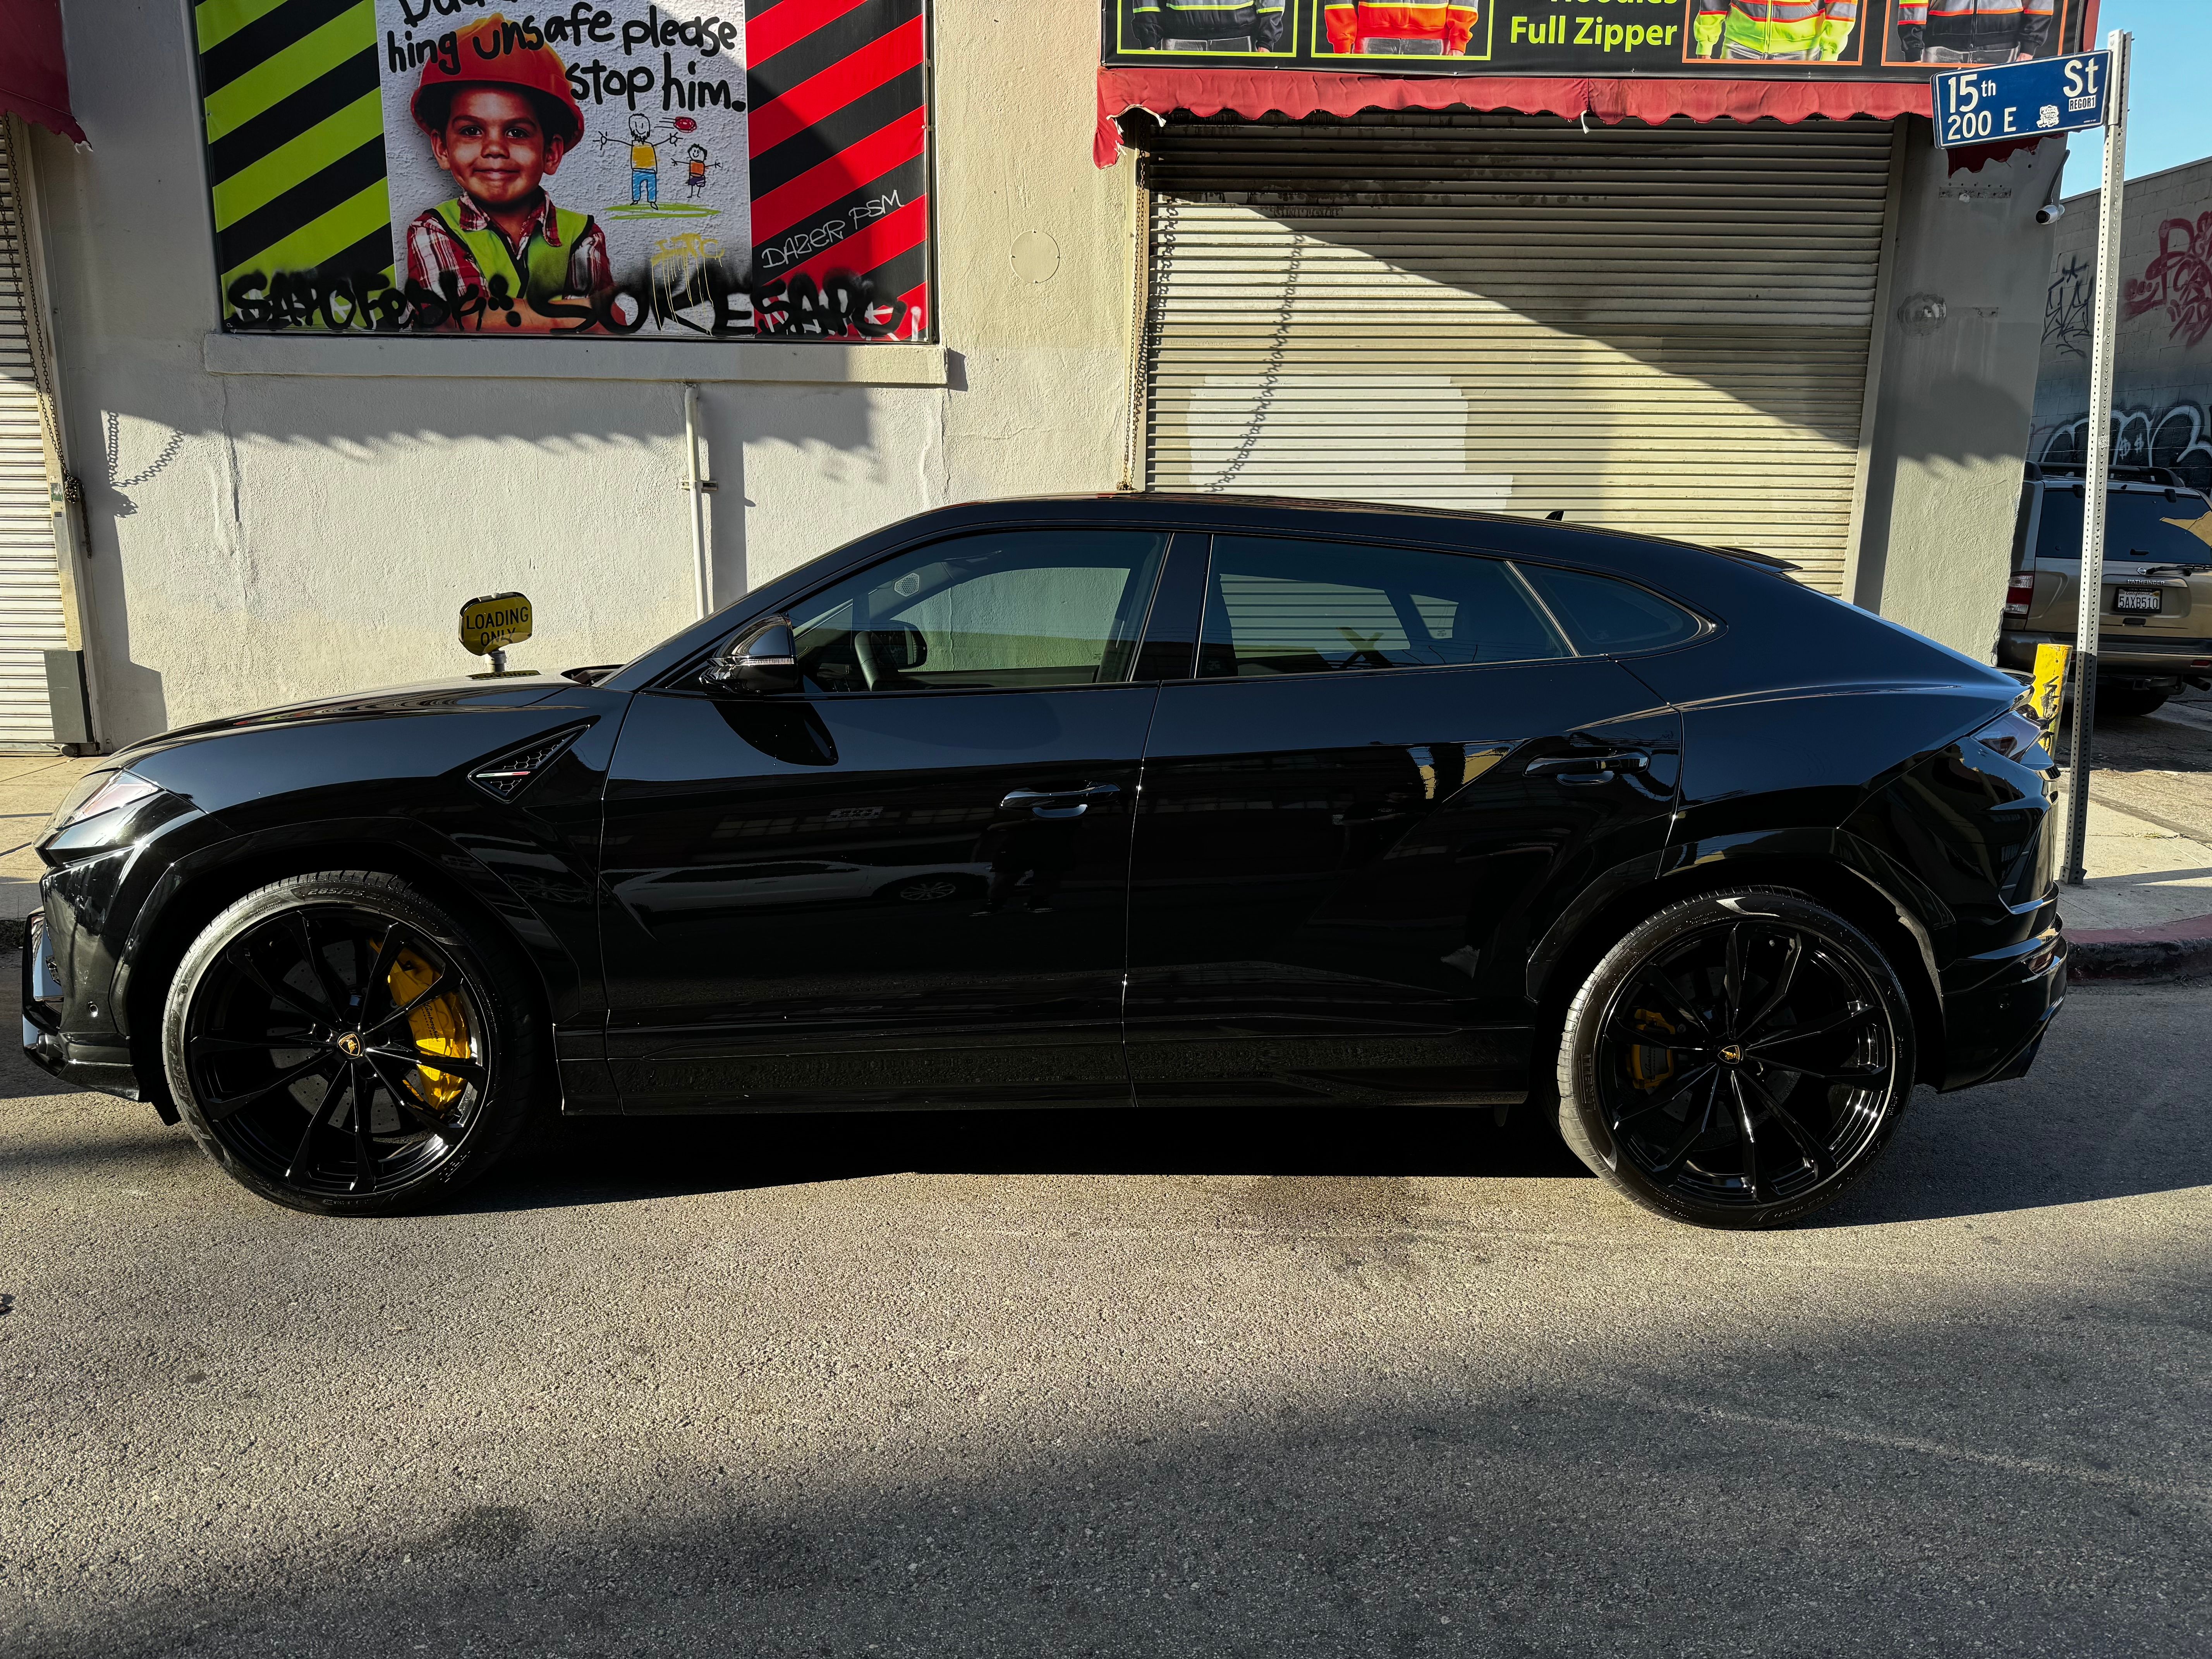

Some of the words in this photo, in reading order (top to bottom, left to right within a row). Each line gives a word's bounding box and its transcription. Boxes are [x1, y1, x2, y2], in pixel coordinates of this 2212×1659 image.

[387, 31, 461, 75] hing
[622, 5, 737, 57] please
[1511, 15, 1566, 44] Full
[1573, 16, 1678, 52] Zipper
[565, 59, 654, 111] stop
[662, 52, 746, 112] him.
[1948, 74, 1996, 113] 15th
[2063, 57, 2099, 98] St
[2069, 97, 2095, 110] REGOR1
[1948, 111, 1992, 141] 200
[2004, 107, 2017, 132] E
[466, 606, 529, 630] LOADING
[2119, 596, 2158, 609] 5AXB510
[480, 627, 516, 647] ONLY
